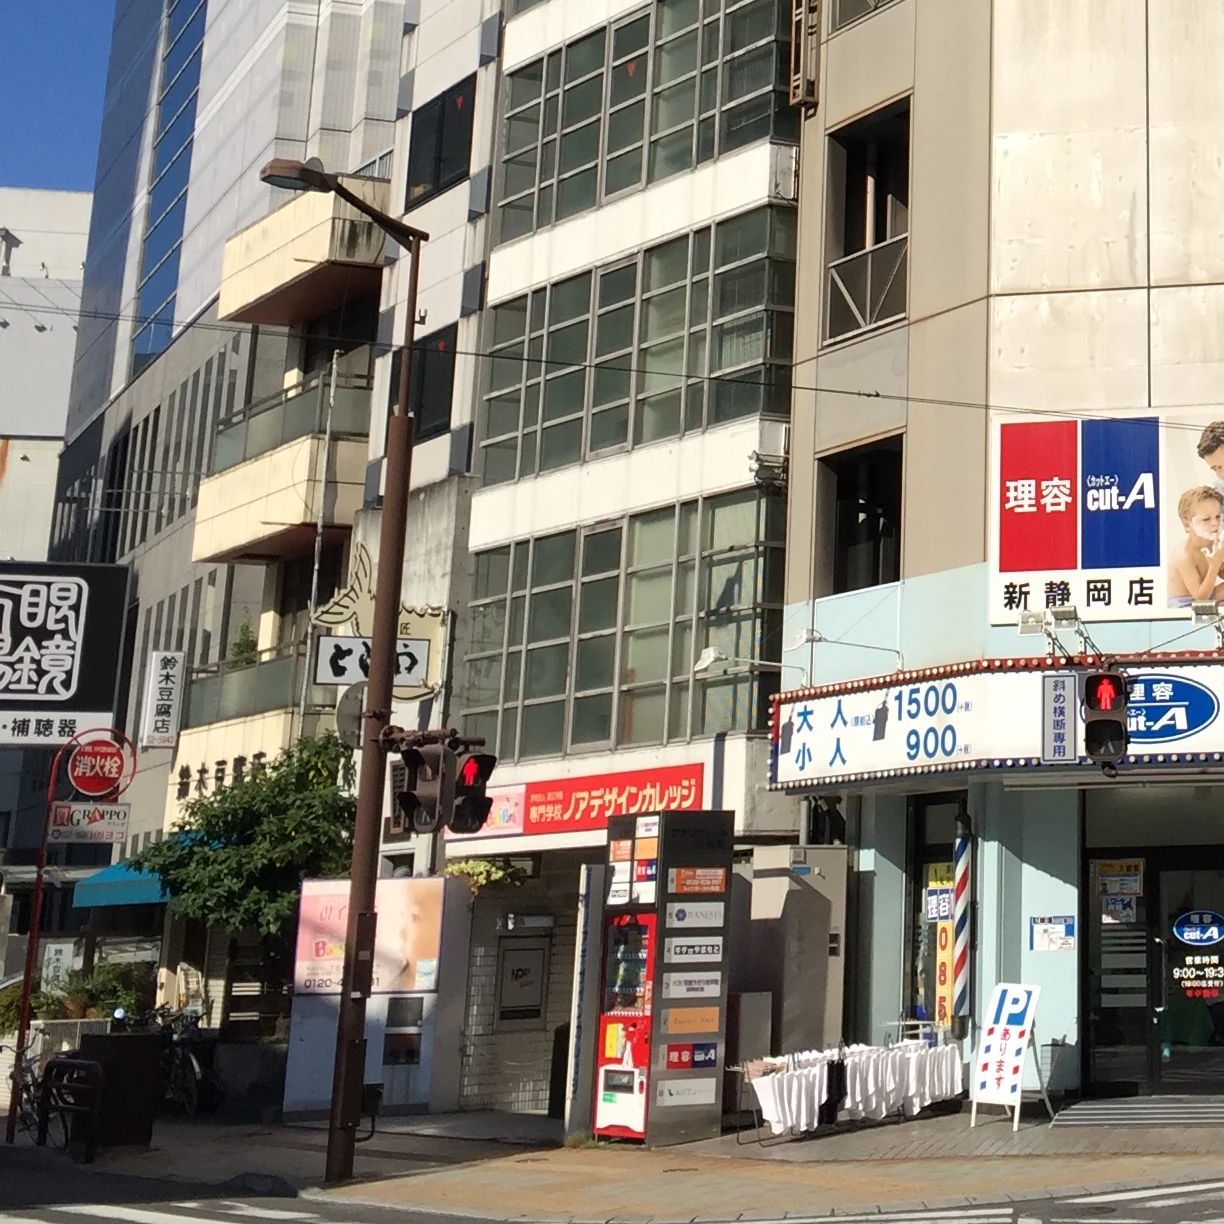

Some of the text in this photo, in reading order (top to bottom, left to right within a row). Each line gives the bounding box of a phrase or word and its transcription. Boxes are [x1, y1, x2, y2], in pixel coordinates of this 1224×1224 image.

[1005, 476, 1073, 514] 理容
[1086, 472, 1156, 511] cut-A
[1003, 577, 1155, 611] 新静岡店
[153, 655, 179, 734] 鈴木豆腐店
[796, 699, 848, 733] 大人
[894, 682, 958, 721] 1500
[1052, 679, 1066, 758] 斜め横断専用
[1127, 707, 1188, 731] ut-A
[74, 755, 121, 778] 消火栓
[795, 737, 848, 771] 小人
[906, 724, 957, 761] 900
[529, 804, 564, 823] 専門学校
[563, 778, 696, 821] ノアデザインカレッジ
[1005, 989, 1028, 1026] P
[995, 1026, 1011, 1090] あります
